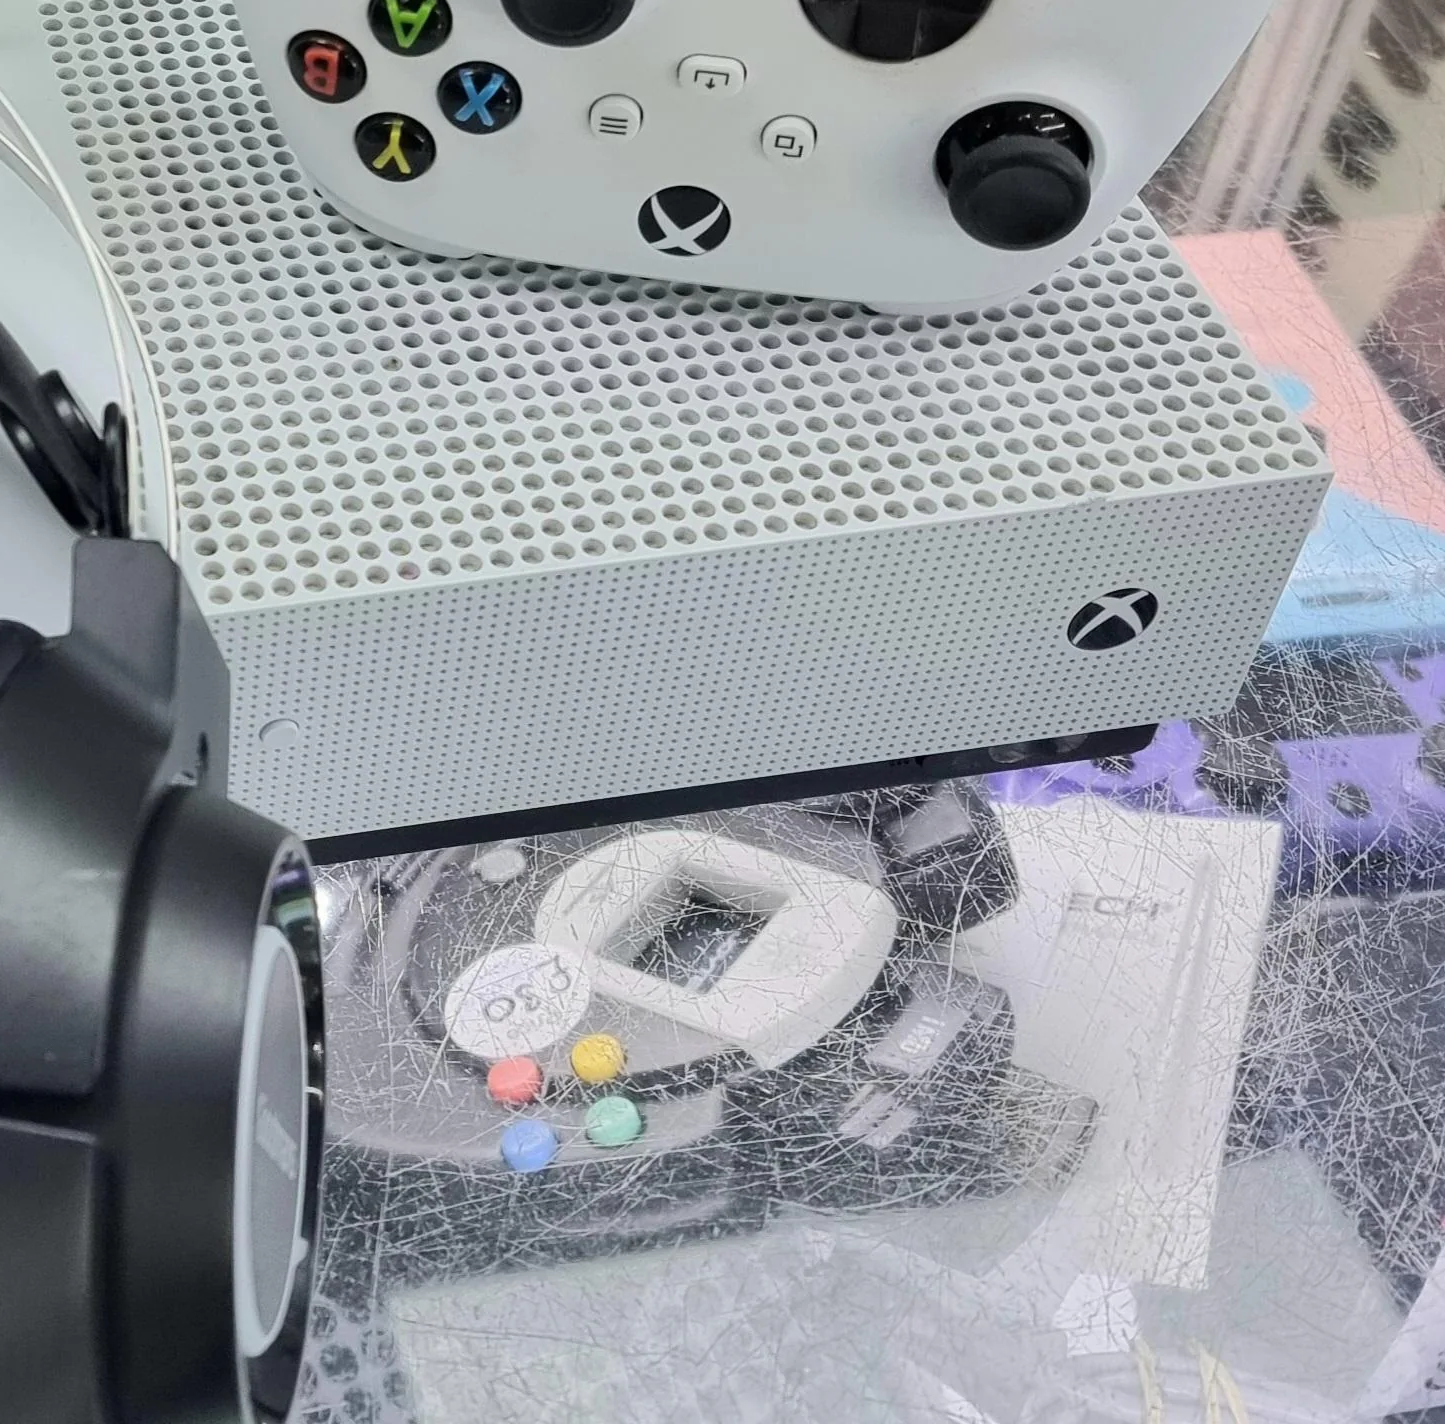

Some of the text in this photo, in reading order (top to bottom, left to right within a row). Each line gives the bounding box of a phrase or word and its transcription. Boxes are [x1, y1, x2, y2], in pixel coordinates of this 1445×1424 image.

[303, 44, 341, 97] B
[454, 68, 505, 127] X
[372, 119, 412, 175] Y
